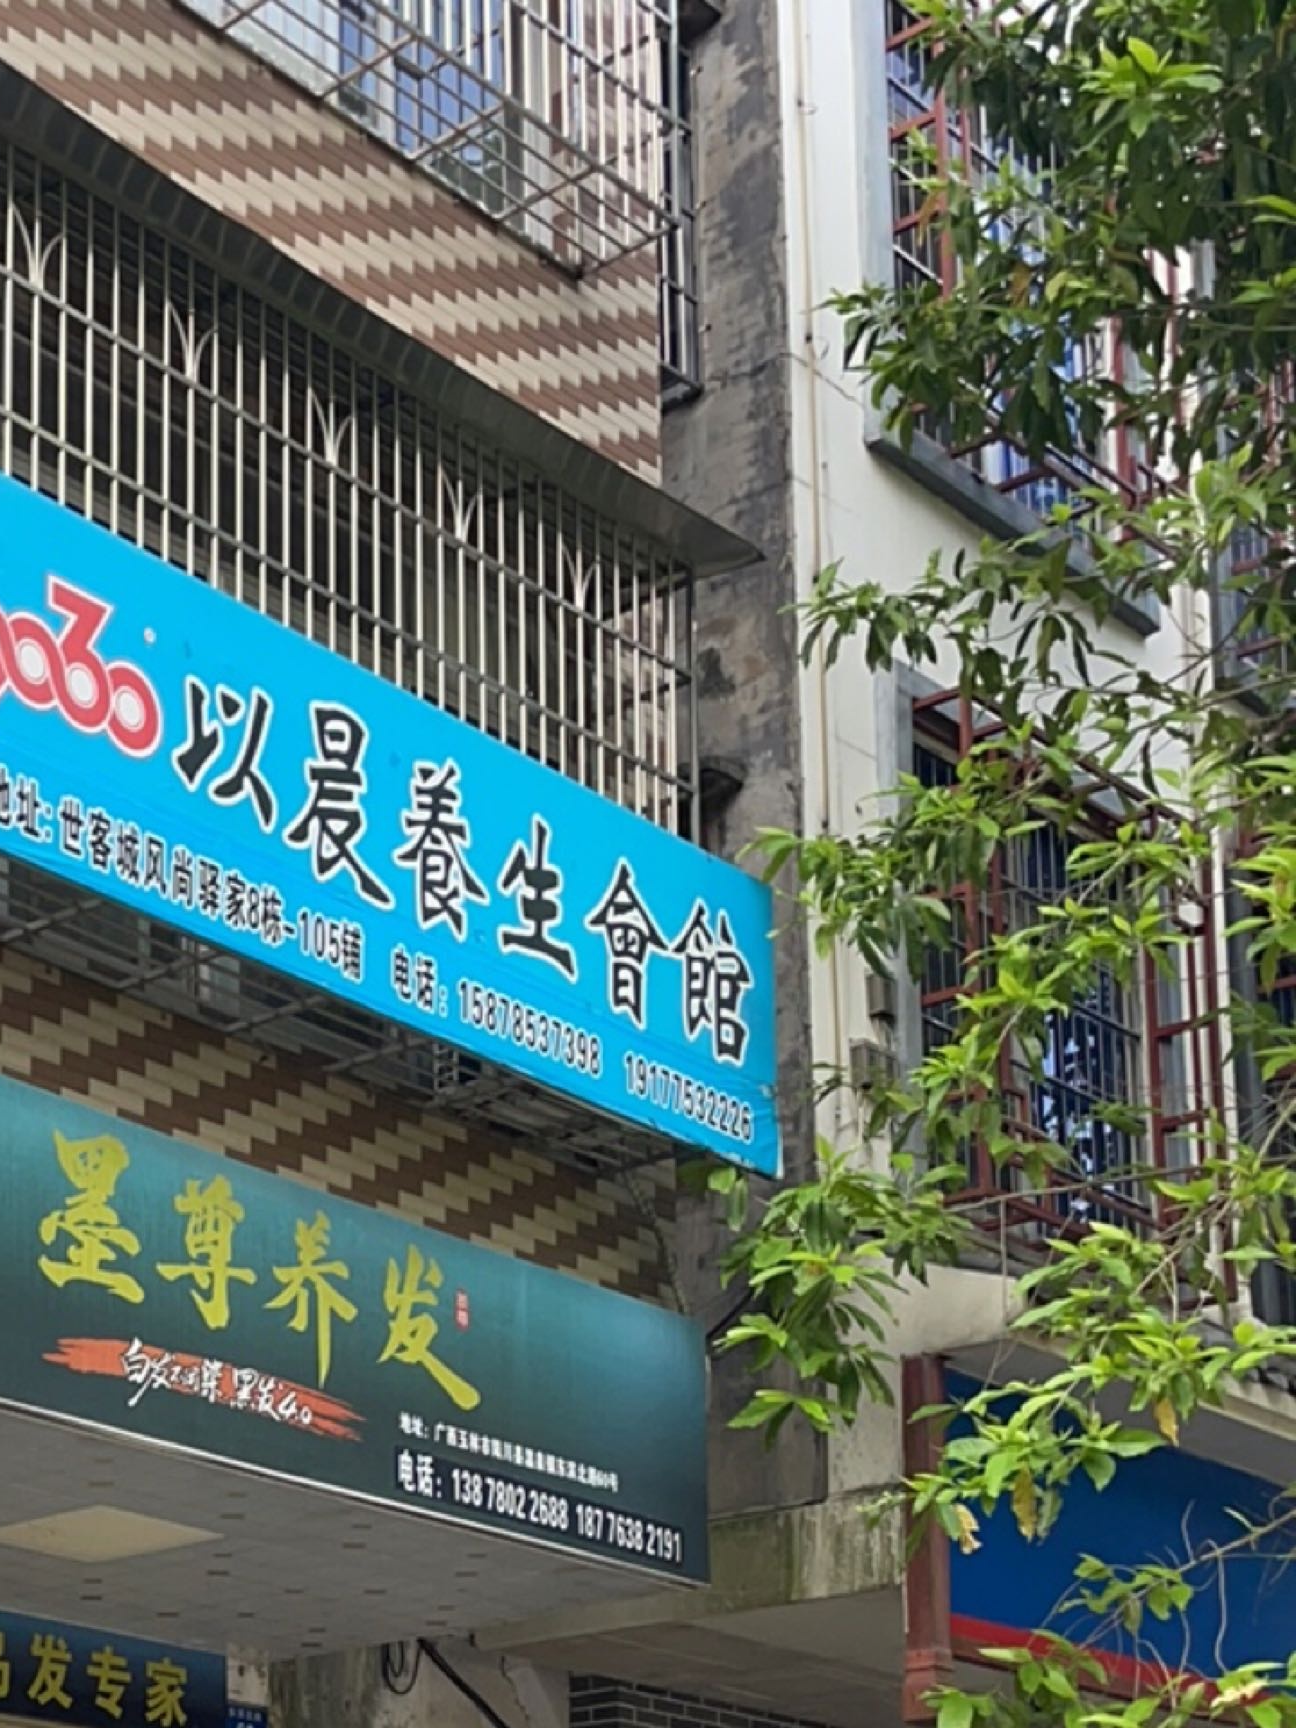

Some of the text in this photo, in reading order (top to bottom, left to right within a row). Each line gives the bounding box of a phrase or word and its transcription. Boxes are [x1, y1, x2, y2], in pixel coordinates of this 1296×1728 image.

[171, 674, 753, 1066] 以晨養生會館
[38, 1129, 481, 1411] 墨尊养发
